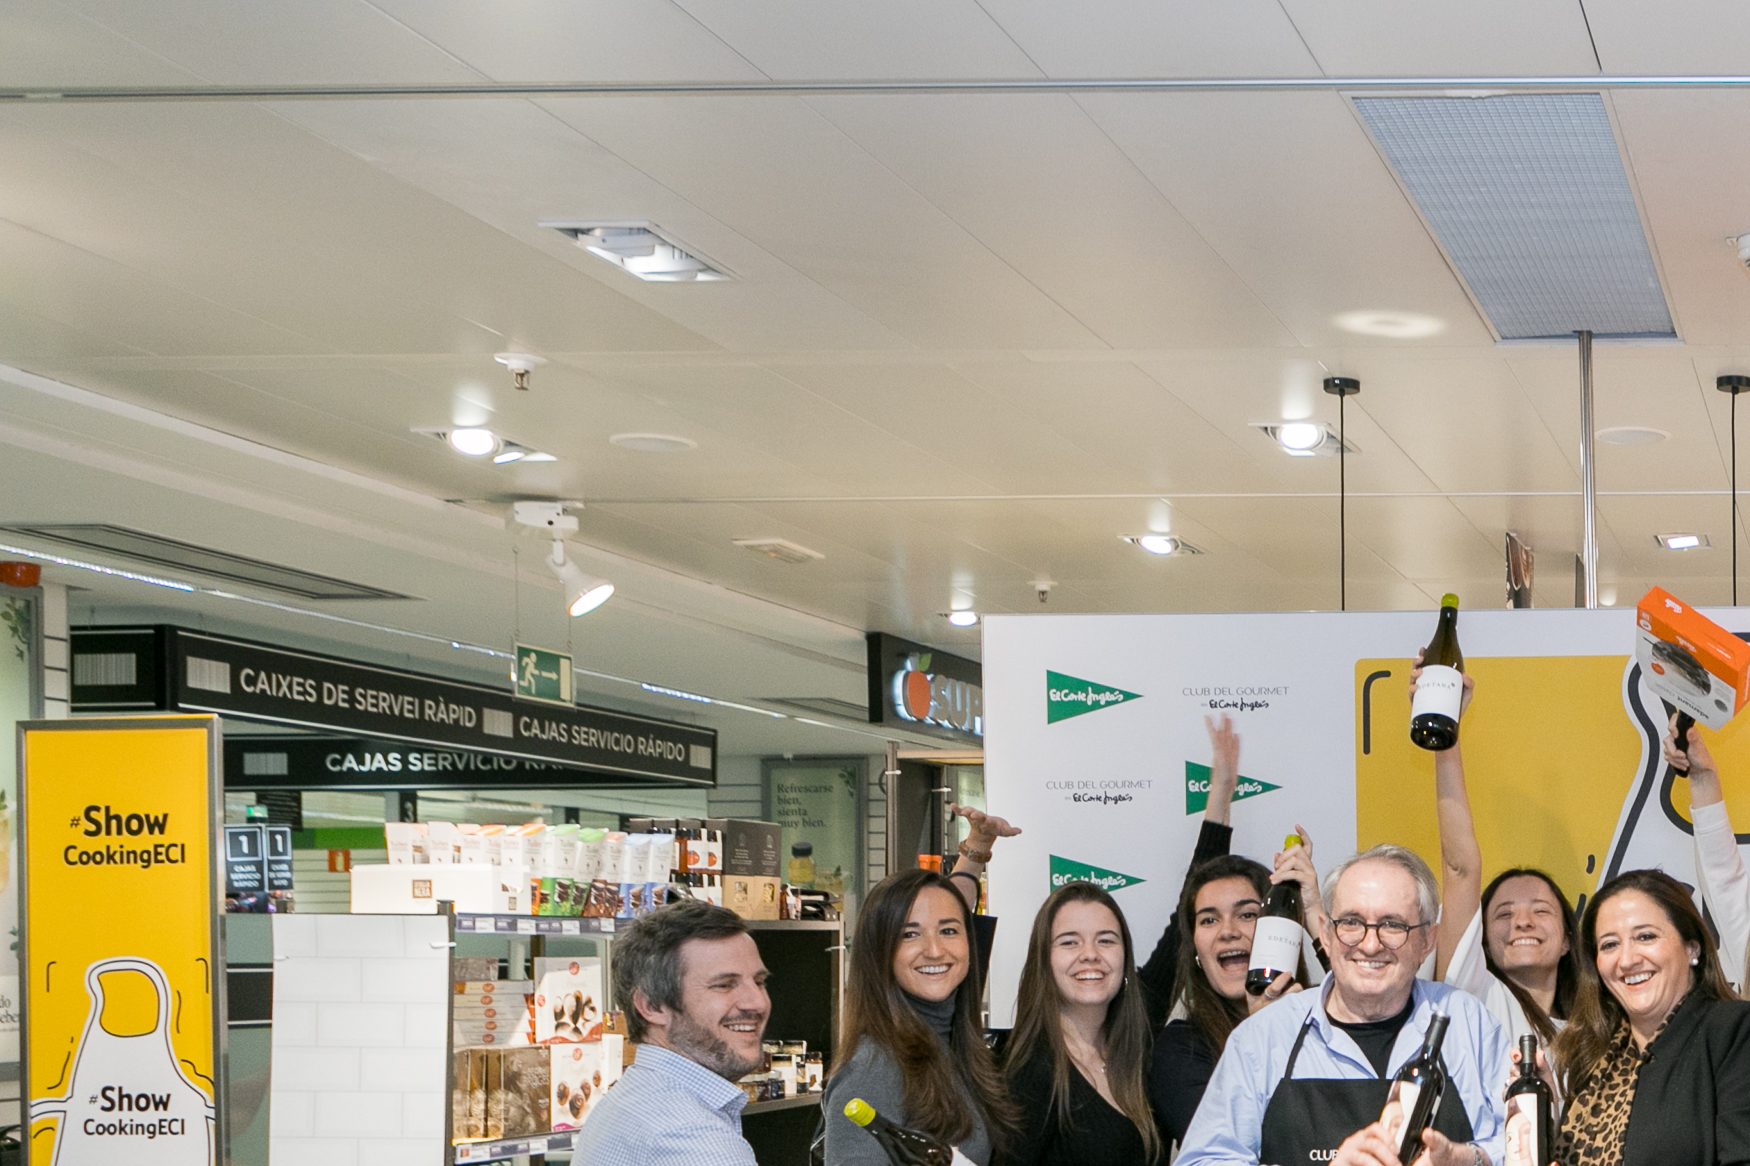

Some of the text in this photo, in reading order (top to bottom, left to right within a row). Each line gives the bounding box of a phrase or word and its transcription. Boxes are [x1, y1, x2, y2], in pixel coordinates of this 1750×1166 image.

[239, 668, 477, 728] CAIXES DE SERVEI RÀPID
[1087, 687, 1124, 705] Inglés
[1182, 686, 1290, 696] CLUB DEL GOURMET
[1219, 700, 1239, 709] Corte
[1239, 698, 1270, 711] Inglés
[519, 716, 686, 762] CAJAS SERVICIO RÁPIDO
[325, 752, 402, 772] CAJAS
[777, 783, 834, 793] Refrescarse
[1046, 780, 1153, 790] CLUB DEL GOURMET
[1082, 794, 1102, 802] Corte
[1103, 791, 1133, 804] Inglés
[70, 804, 169, 838] #Show
[777, 807, 808, 816] sienta
[238, 834, 249, 855] 1
[63, 843, 186, 869] CookingECI
[89, 1086, 171, 1112] #Show
[83, 1118, 185, 1139] CookingECI
